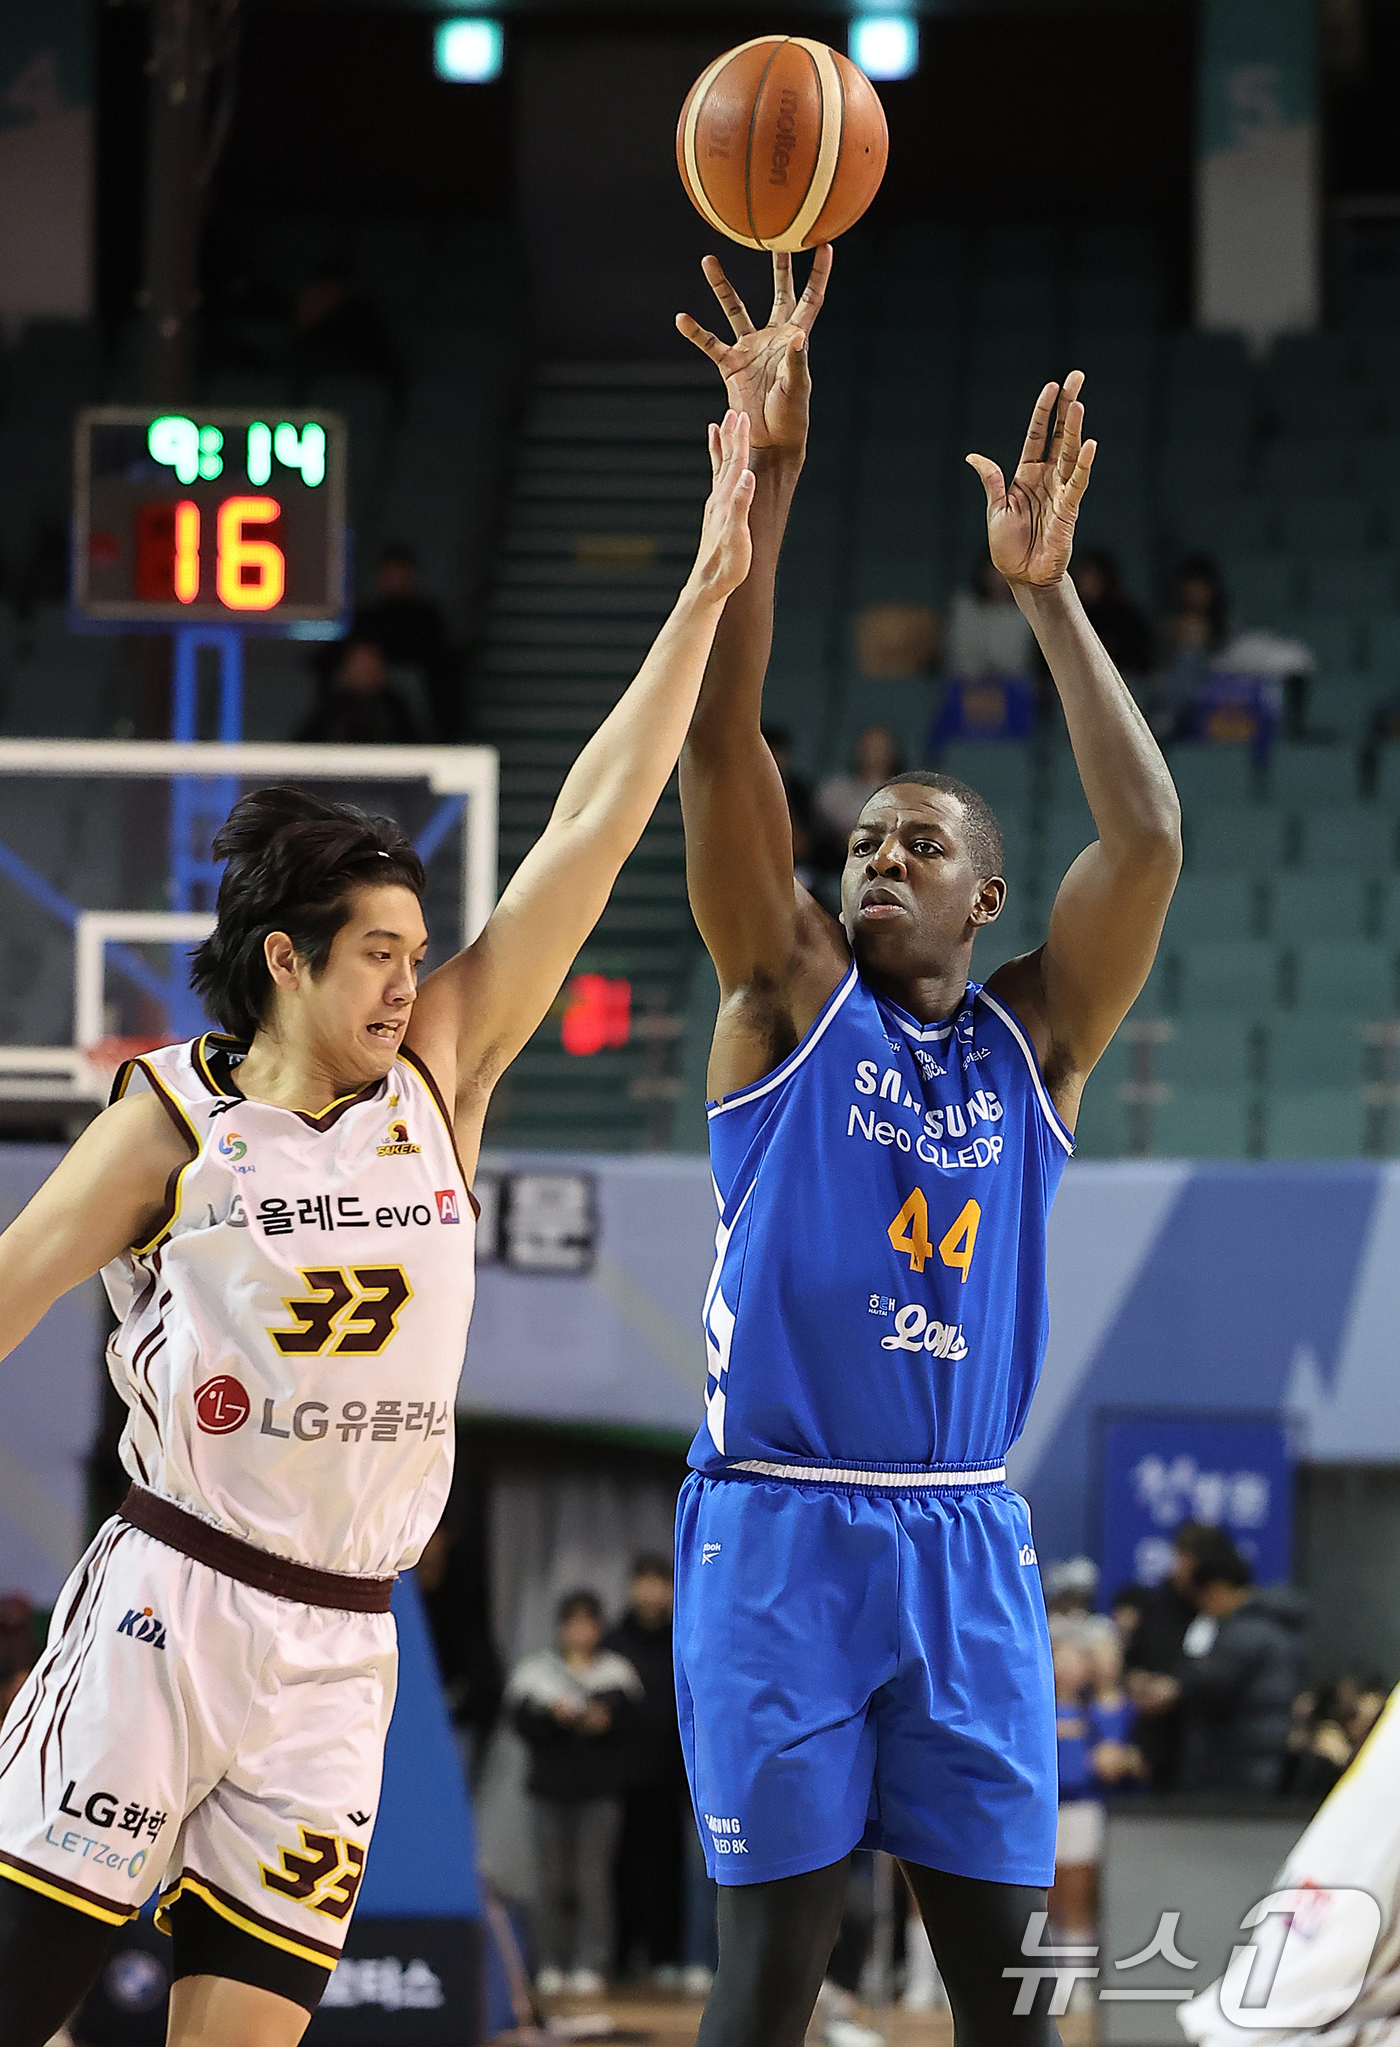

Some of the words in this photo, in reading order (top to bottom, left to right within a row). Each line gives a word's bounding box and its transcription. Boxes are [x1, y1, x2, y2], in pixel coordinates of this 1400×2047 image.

[769, 88, 799, 186] molten
[148, 415, 326, 487] 9:14
[173, 496, 286, 611] 16
[847, 1104, 912, 1152] Neo
[256, 1195, 370, 1236] 올레드
[375, 1204, 432, 1228] evo
[437, 1191, 459, 1222] AI
[887, 1186, 982, 1283] 44
[265, 1263, 415, 1357] 33
[257, 1823, 366, 1921] 33
[731, 1838, 749, 1854] 8K
